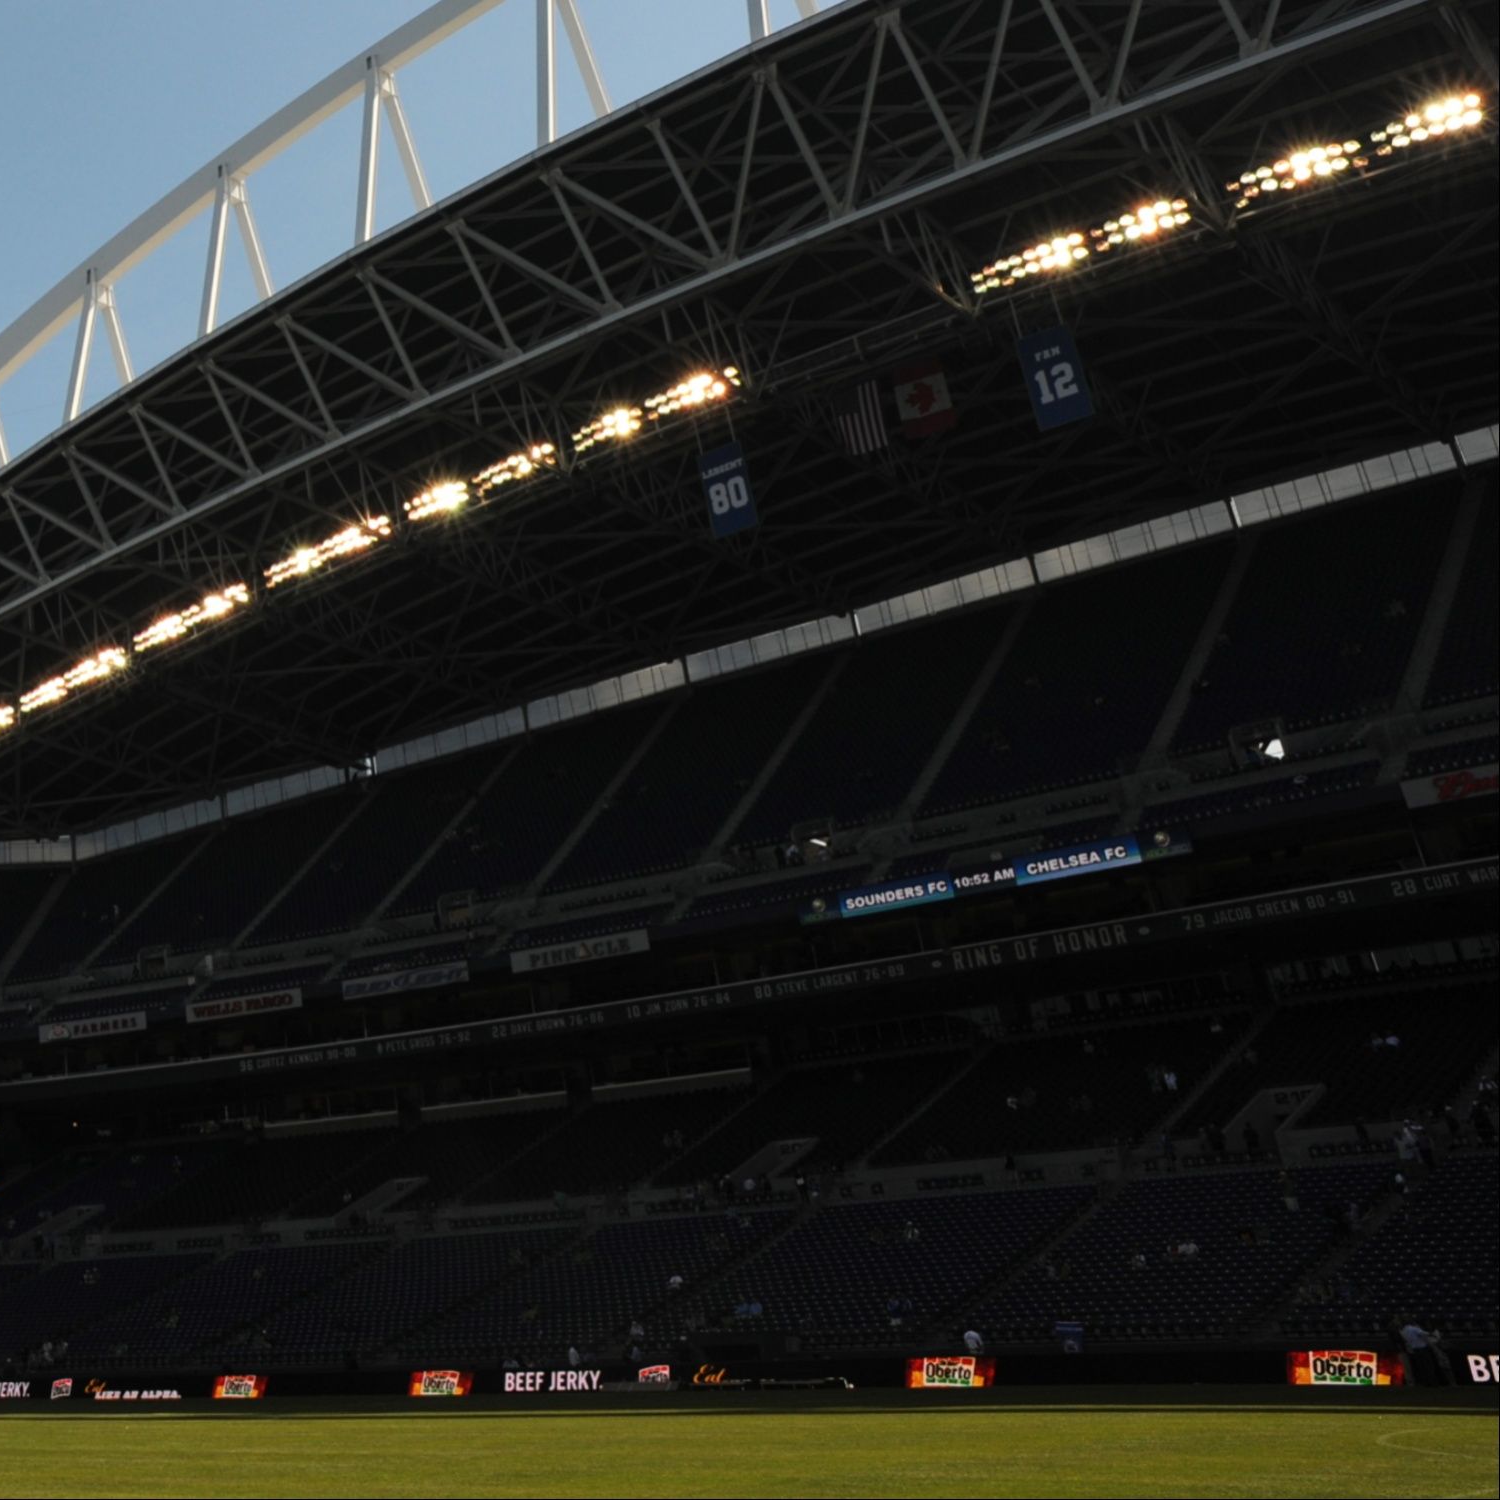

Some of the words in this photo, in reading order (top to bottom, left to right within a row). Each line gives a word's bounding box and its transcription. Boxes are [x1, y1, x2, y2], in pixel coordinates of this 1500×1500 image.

[1033, 345, 1060, 362] FAN
[1033, 361, 1079, 405] 12
[708, 475, 749, 515] 80
[845, 884, 924, 909] SOUNDERS
[927, 880, 947, 895] FC
[953, 870, 991, 889] 10:52
[993, 867, 1015, 882] AM
[1026, 851, 1100, 875] CHELSEA
[1103, 846, 1126, 861] FC
[1390, 878, 1418, 898] 28
[1422, 871, 1461, 891] CURT
[1182, 913, 1206, 931] 79
[1212, 906, 1252, 926] JACOB
[1256, 899, 1301, 918] GREEN
[952, 944, 1001, 971] RING
[1014, 937, 1039, 961] OF
[1053, 923, 1128, 954] HONOR
[753, 984, 772, 1000] 80
[775, 981, 808, 996] STEVE
[812, 971, 861, 989] LARGENT
[193, 1000, 243, 1018] WELLS
[245, 993, 293, 1011] FARGO
[626, 1004, 642, 1019] 10
[645, 1002, 662, 1016] JIM
[664, 999, 690, 1014] ZORN
[73, 1016, 138, 1035] FARMERS
[492, 1025, 508, 1039] 22
[510, 1021, 533, 1036] DAVE
[535, 1018, 566, 1033] BROWN
[693, 1363, 727, 1384] Eat
[926, 1362, 971, 1380] Oberto
[1312, 1357, 1373, 1379] Oberto
[504, 1371, 545, 1392] BEEF
[548, 1369, 603, 1391] JERKY.
